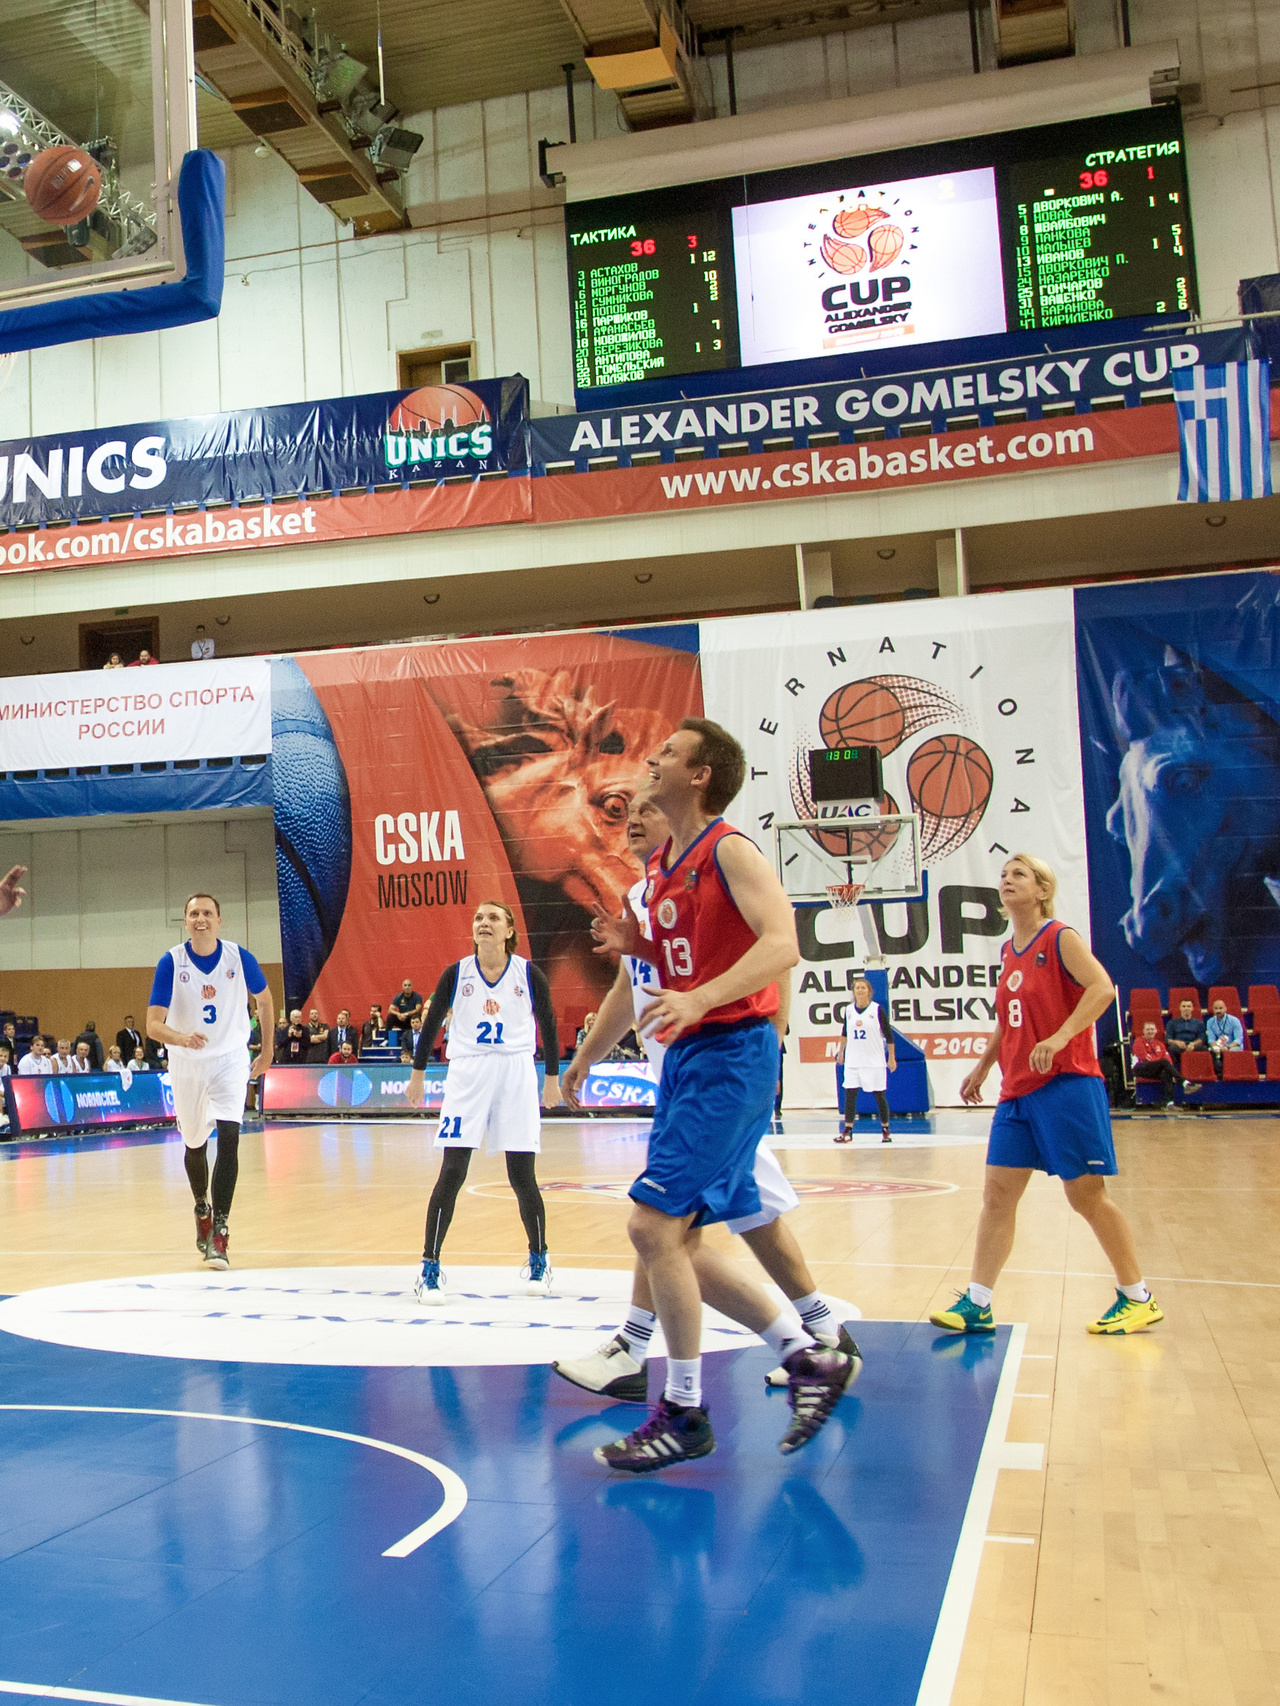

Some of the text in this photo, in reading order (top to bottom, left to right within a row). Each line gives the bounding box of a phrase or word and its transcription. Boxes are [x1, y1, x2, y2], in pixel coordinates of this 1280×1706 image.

[1085, 141, 1180, 167] СТРАТЕГИЯ
[1079, 166, 1154, 189] 36 1
[1018, 191, 1124, 215] 5 ДВОРКОВИЧ А.
[1019, 193, 1179, 224] 7 НОВАК 1 4
[571, 225, 636, 246] ТАКТИКА
[1020, 214, 1106, 235] 8 ШВАЙБОВИЧ
[1021, 228, 1090, 246] 9 ПАНКОВА
[630, 235, 697, 256] 36 3
[1016, 224, 1181, 257] 10 МАЛЬЦЕВ 5
[1017, 236, 1181, 267] 13 ИВАНОВ 1 1
[578, 250, 716, 280] 3 АСТАХОВ 1 12
[1018, 246, 1183, 277] 15 ДВОРКОВИЧ П. 4
[578, 270, 659, 289] 4 ВИНОГРАДОВ
[579, 270, 717, 299] 6 МОРГУНОВ 10
[1017, 267, 1109, 288] 24 НАЗАРЕНКО
[1018, 278, 1103, 299] 25 ГОНЧАРОВ
[575, 281, 718, 310] 12 СУМНИКОВА 2
[575, 291, 718, 319] 14 ПОПОВ 2
[821, 276, 910, 311] CUP
[1019, 277, 1186, 309] 31 ВАЩЕНКО 2
[1019, 289, 1187, 318] 44 БАРАНОВА 3
[575, 303, 699, 329] 16 ПАРШИКОВ 1
[825, 301, 912, 323] ALEXANDER
[828, 313, 909, 334] GOMELSKY
[1020, 299, 1188, 330] 47 КИРИЛЕНКО 2 6
[576, 319, 655, 338] 17 АФАНАСЬЕВ
[576, 319, 720, 349] 18 НОВОЖИЛОВ 7
[575, 338, 663, 358] 20 БЕРЕЗИКОВА
[576, 340, 721, 368] 21 АНТИПОВА 1 3
[577, 357, 664, 377] 22 ГОМЕЛЬСКИЙ
[577, 370, 644, 388] 23 ПОЛЯКОВ
[569, 343, 1200, 453] ALEXANDER GOMELSKY CUP
[384, 425, 493, 468] UNICS
[388, 460, 488, 479] KAZAN
[660, 427, 1095, 500] www.cskabasket.com
[169, 686, 255, 707] СПОРТА
[77, 718, 165, 740] РОССИИ
[751, 636, 1035, 866] INTERNATIONAL
[375, 810, 465, 865] CSKA
[378, 870, 467, 908] MOSCOW
[794, 885, 1009, 962] CUP
[662, 937, 693, 976] 13
[631, 957, 651, 986] 14
[799, 965, 1002, 993] ALEANDE
[203, 1005, 216, 1024] 3
[809, 998, 997, 1025] GOELSKY
[1008, 999, 1023, 1027] 8
[477, 1022, 504, 1044] 21
[853, 1030, 867, 1040] 12
[932, 1038, 987, 1055] 2016
[76, 1090, 120, 1108] NORNICKEL
[591, 1080, 656, 1105] CSKA
[438, 1116, 462, 1138] 21
